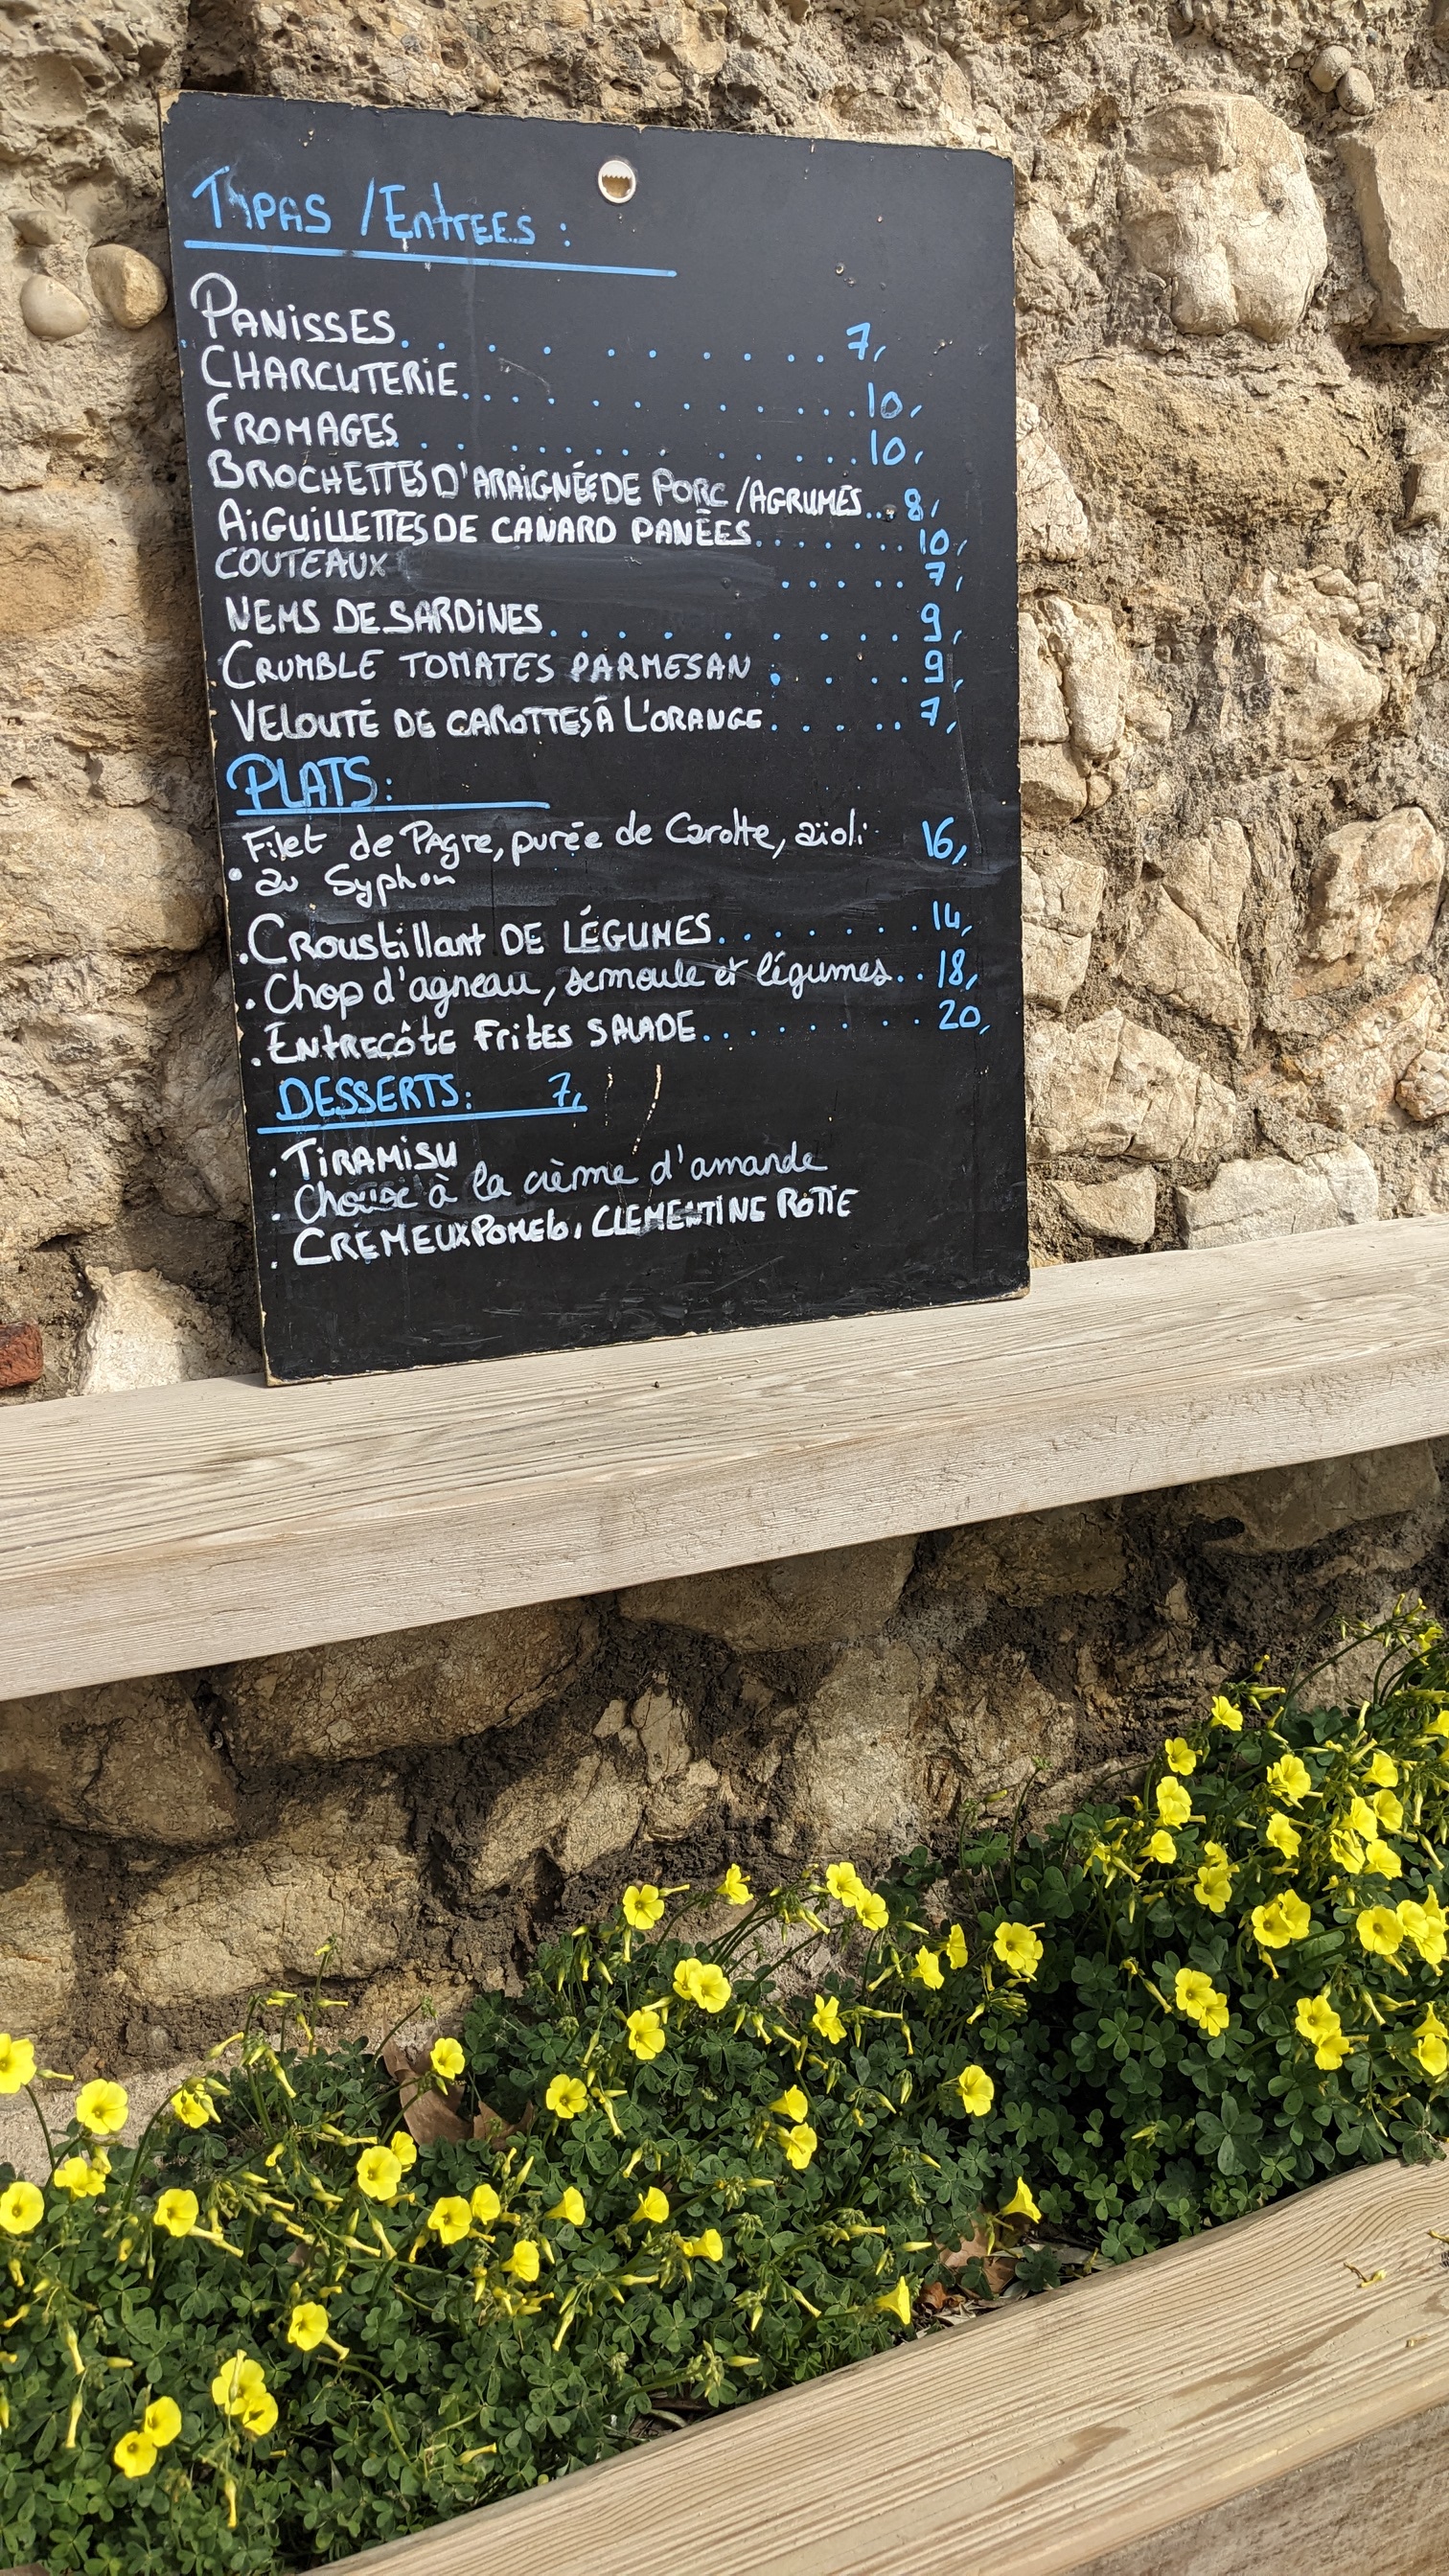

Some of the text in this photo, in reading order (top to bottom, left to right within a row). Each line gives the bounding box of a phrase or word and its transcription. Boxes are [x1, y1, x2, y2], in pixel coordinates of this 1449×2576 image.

[191, 272, 395, 344] PANISSES
[201, 345, 458, 396] CHARCUTERIE
[206, 393, 398, 448] FROMAGES
[652, 468, 729, 508] PORC
[433, 514, 479, 543] DE
[491, 516, 617, 544] CANARD
[631, 508, 752, 547] PANÉES
[214, 546, 389, 581] COUTEAUX
[224, 596, 321, 635] NEMS
[333, 598, 380, 635] DE
[382, 595, 543, 635] SARDINES
[221, 639, 384, 689] CRUMBLE
[398, 650, 555, 684] TOMATES
[571, 652, 751, 684] PARMESAN
[230, 699, 380, 742] VELOUTÉ
[393, 707, 437, 739] DE
[446, 703, 591, 739] CAROTTES
[624, 696, 764, 734] L'ORANGE
[242, 823, 328, 863] Filet
[350, 824, 394, 861] de
[511, 821, 603, 866] purée
[615, 808, 653, 847] de
[255, 862, 456, 908] au Syphon
[500, 921, 544, 956] DE
[564, 905, 712, 954] LÉGUMES
[264, 968, 364, 1022] Chop
[564, 958, 706, 997] semoule
[714, 956, 748, 987] et
[755, 951, 892, 1000] légumes
[586, 1009, 697, 1048] SALADE
[280, 1135, 458, 1181] TIRAMISU
[427, 1172, 458, 1209] à
[472, 1160, 513, 1202] la
[650, 1140, 829, 1186] d'amande
